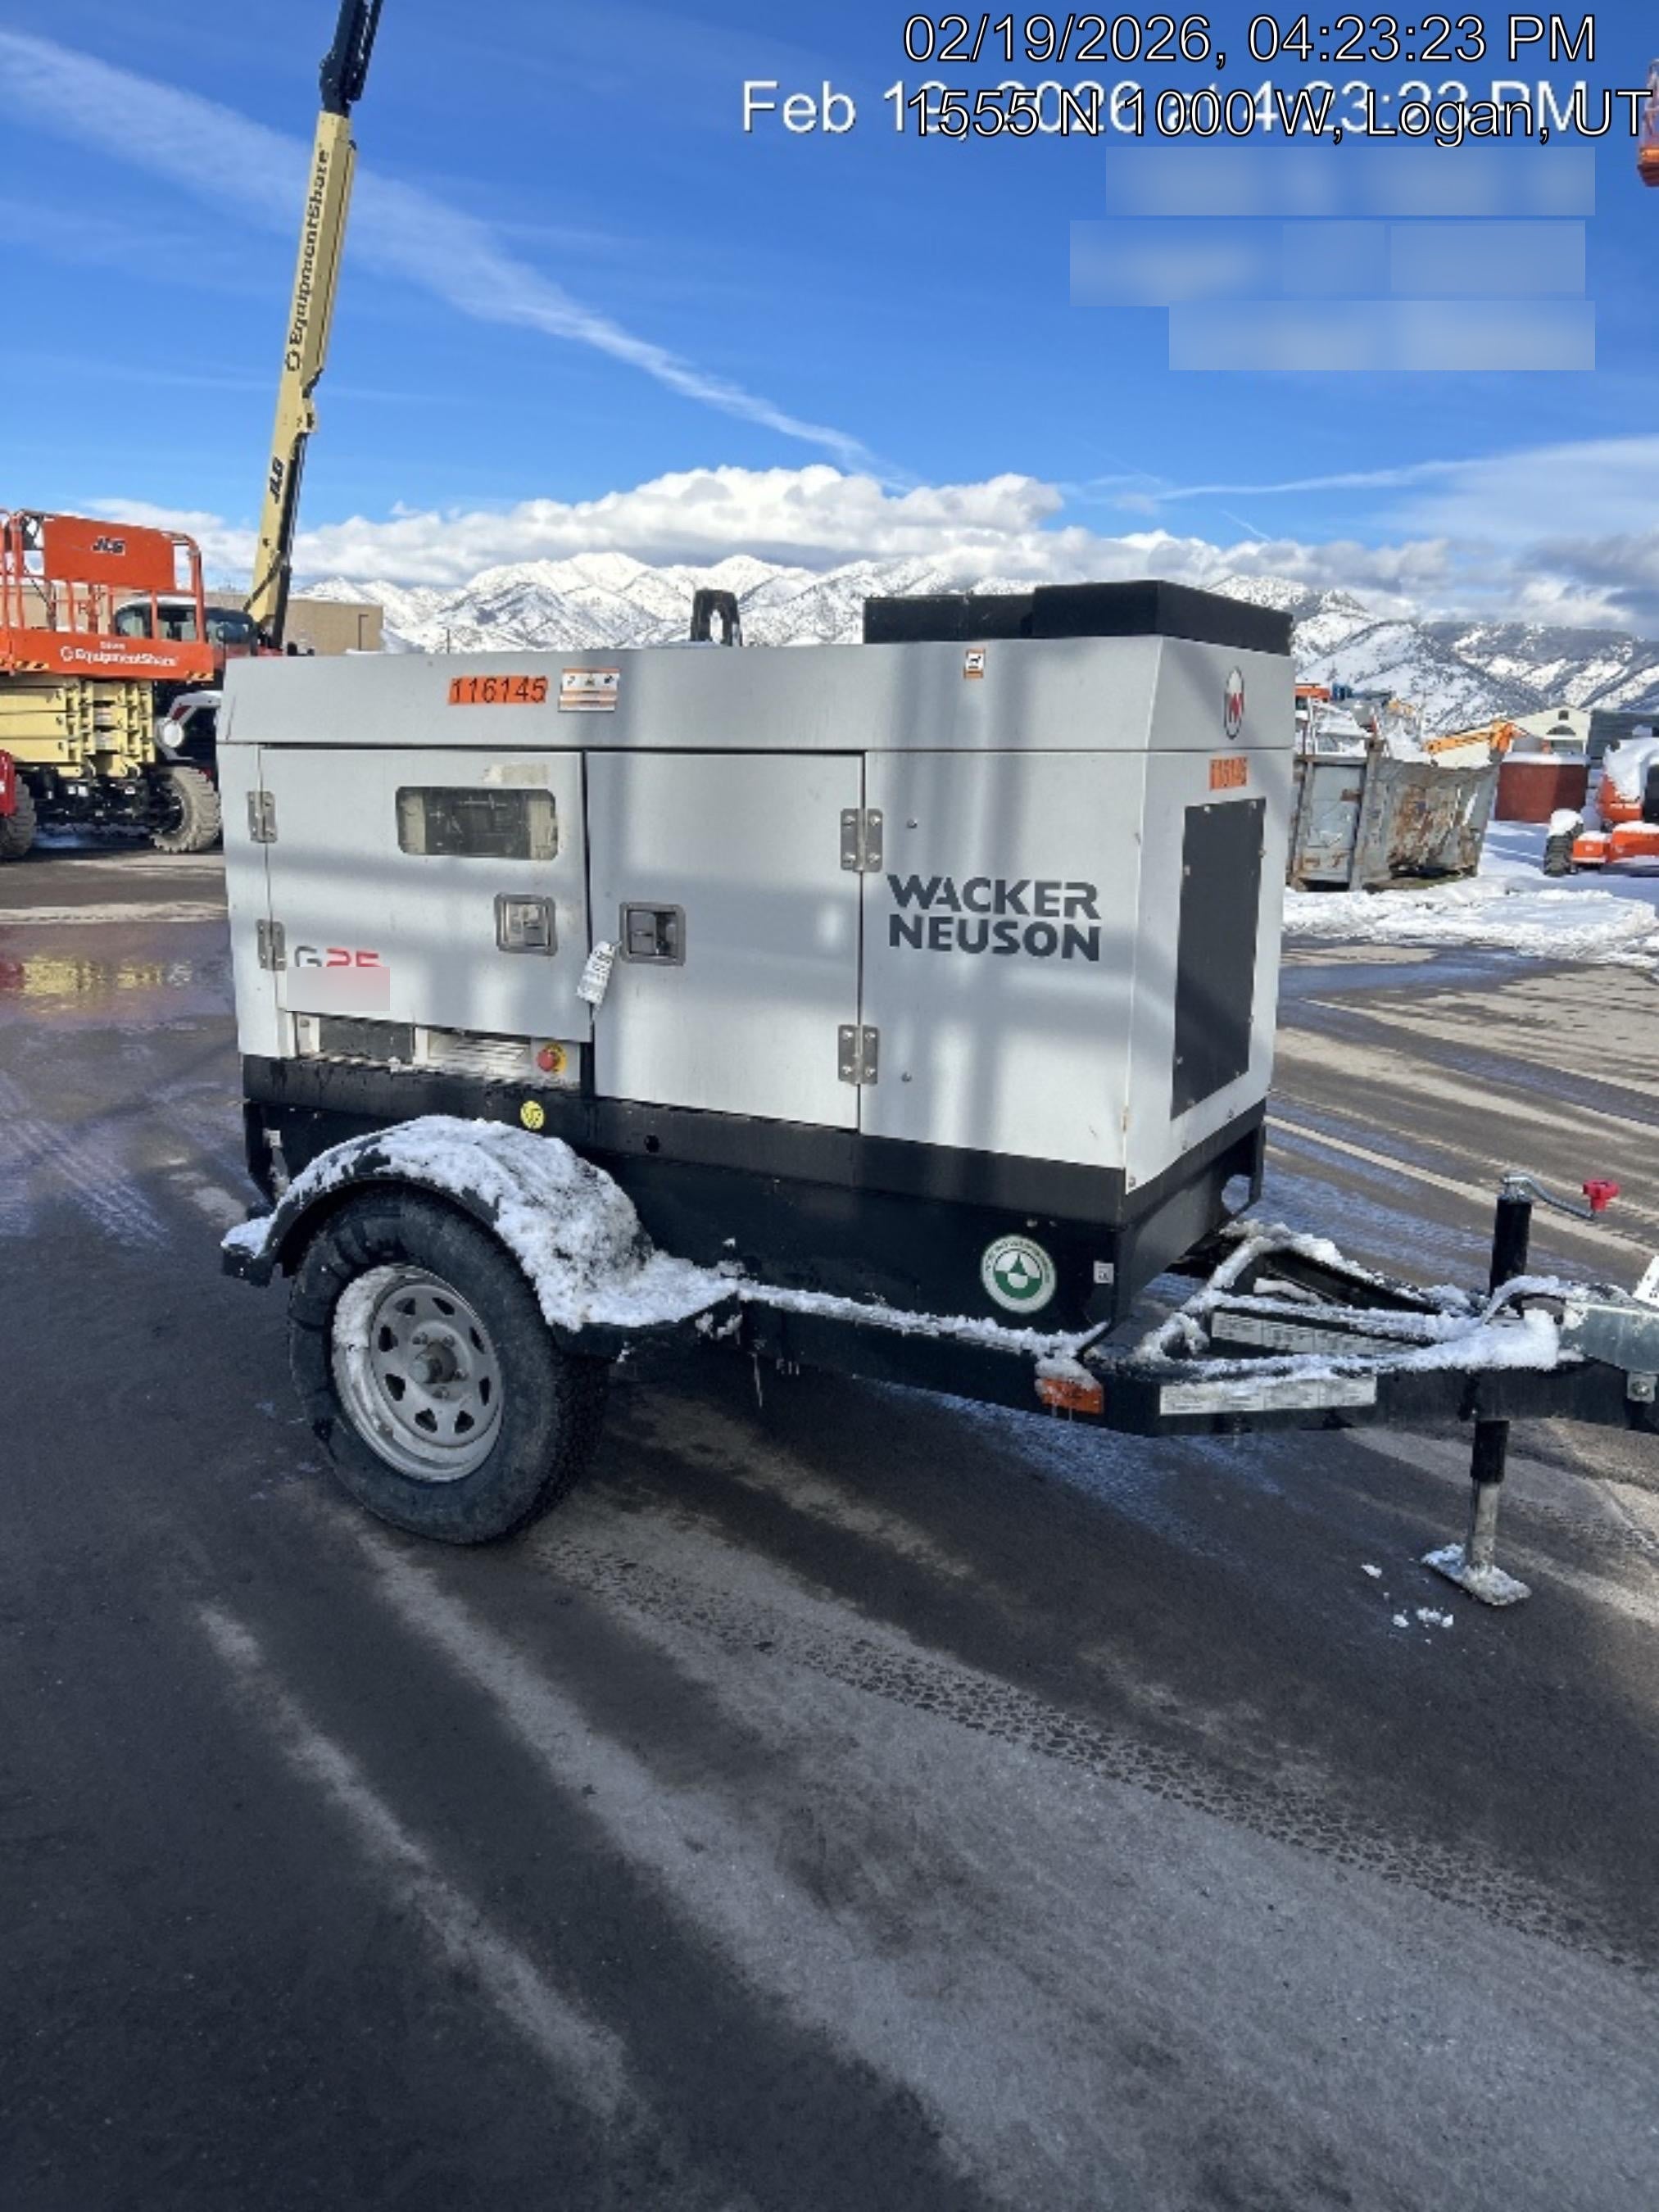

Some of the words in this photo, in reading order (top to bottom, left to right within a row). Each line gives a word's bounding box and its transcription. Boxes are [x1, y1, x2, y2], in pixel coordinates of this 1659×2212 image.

[451, 676, 548, 705] 116145
[886, 874, 1101, 920] WACKER
[889, 913, 1099, 962] NEUSON
